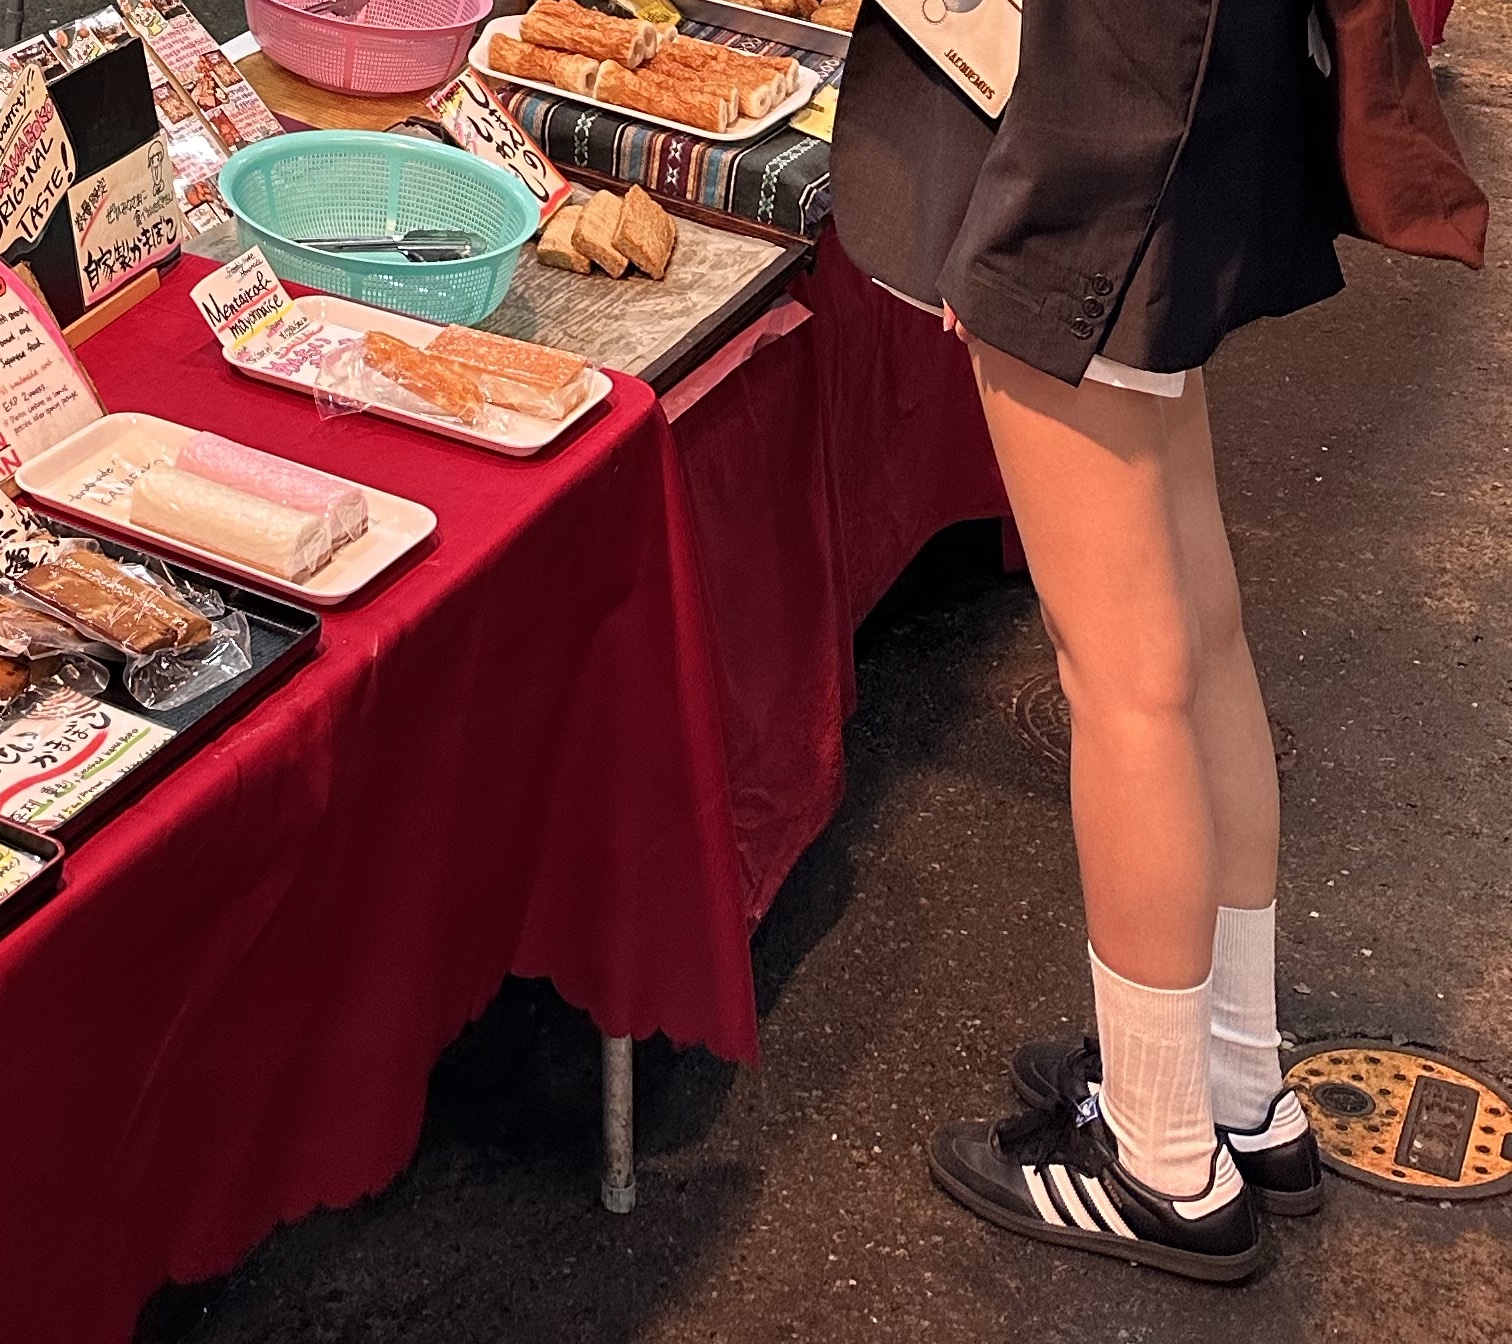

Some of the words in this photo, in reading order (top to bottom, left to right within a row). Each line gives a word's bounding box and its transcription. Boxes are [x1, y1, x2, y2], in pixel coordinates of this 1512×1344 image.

[943, 48, 995, 102] JACQUEMUS
[16, 142, 75, 243] TASTE!
[86, 216, 177, 293] 自家製かまぼこ
[29, 711, 111, 769] かまぼこ
